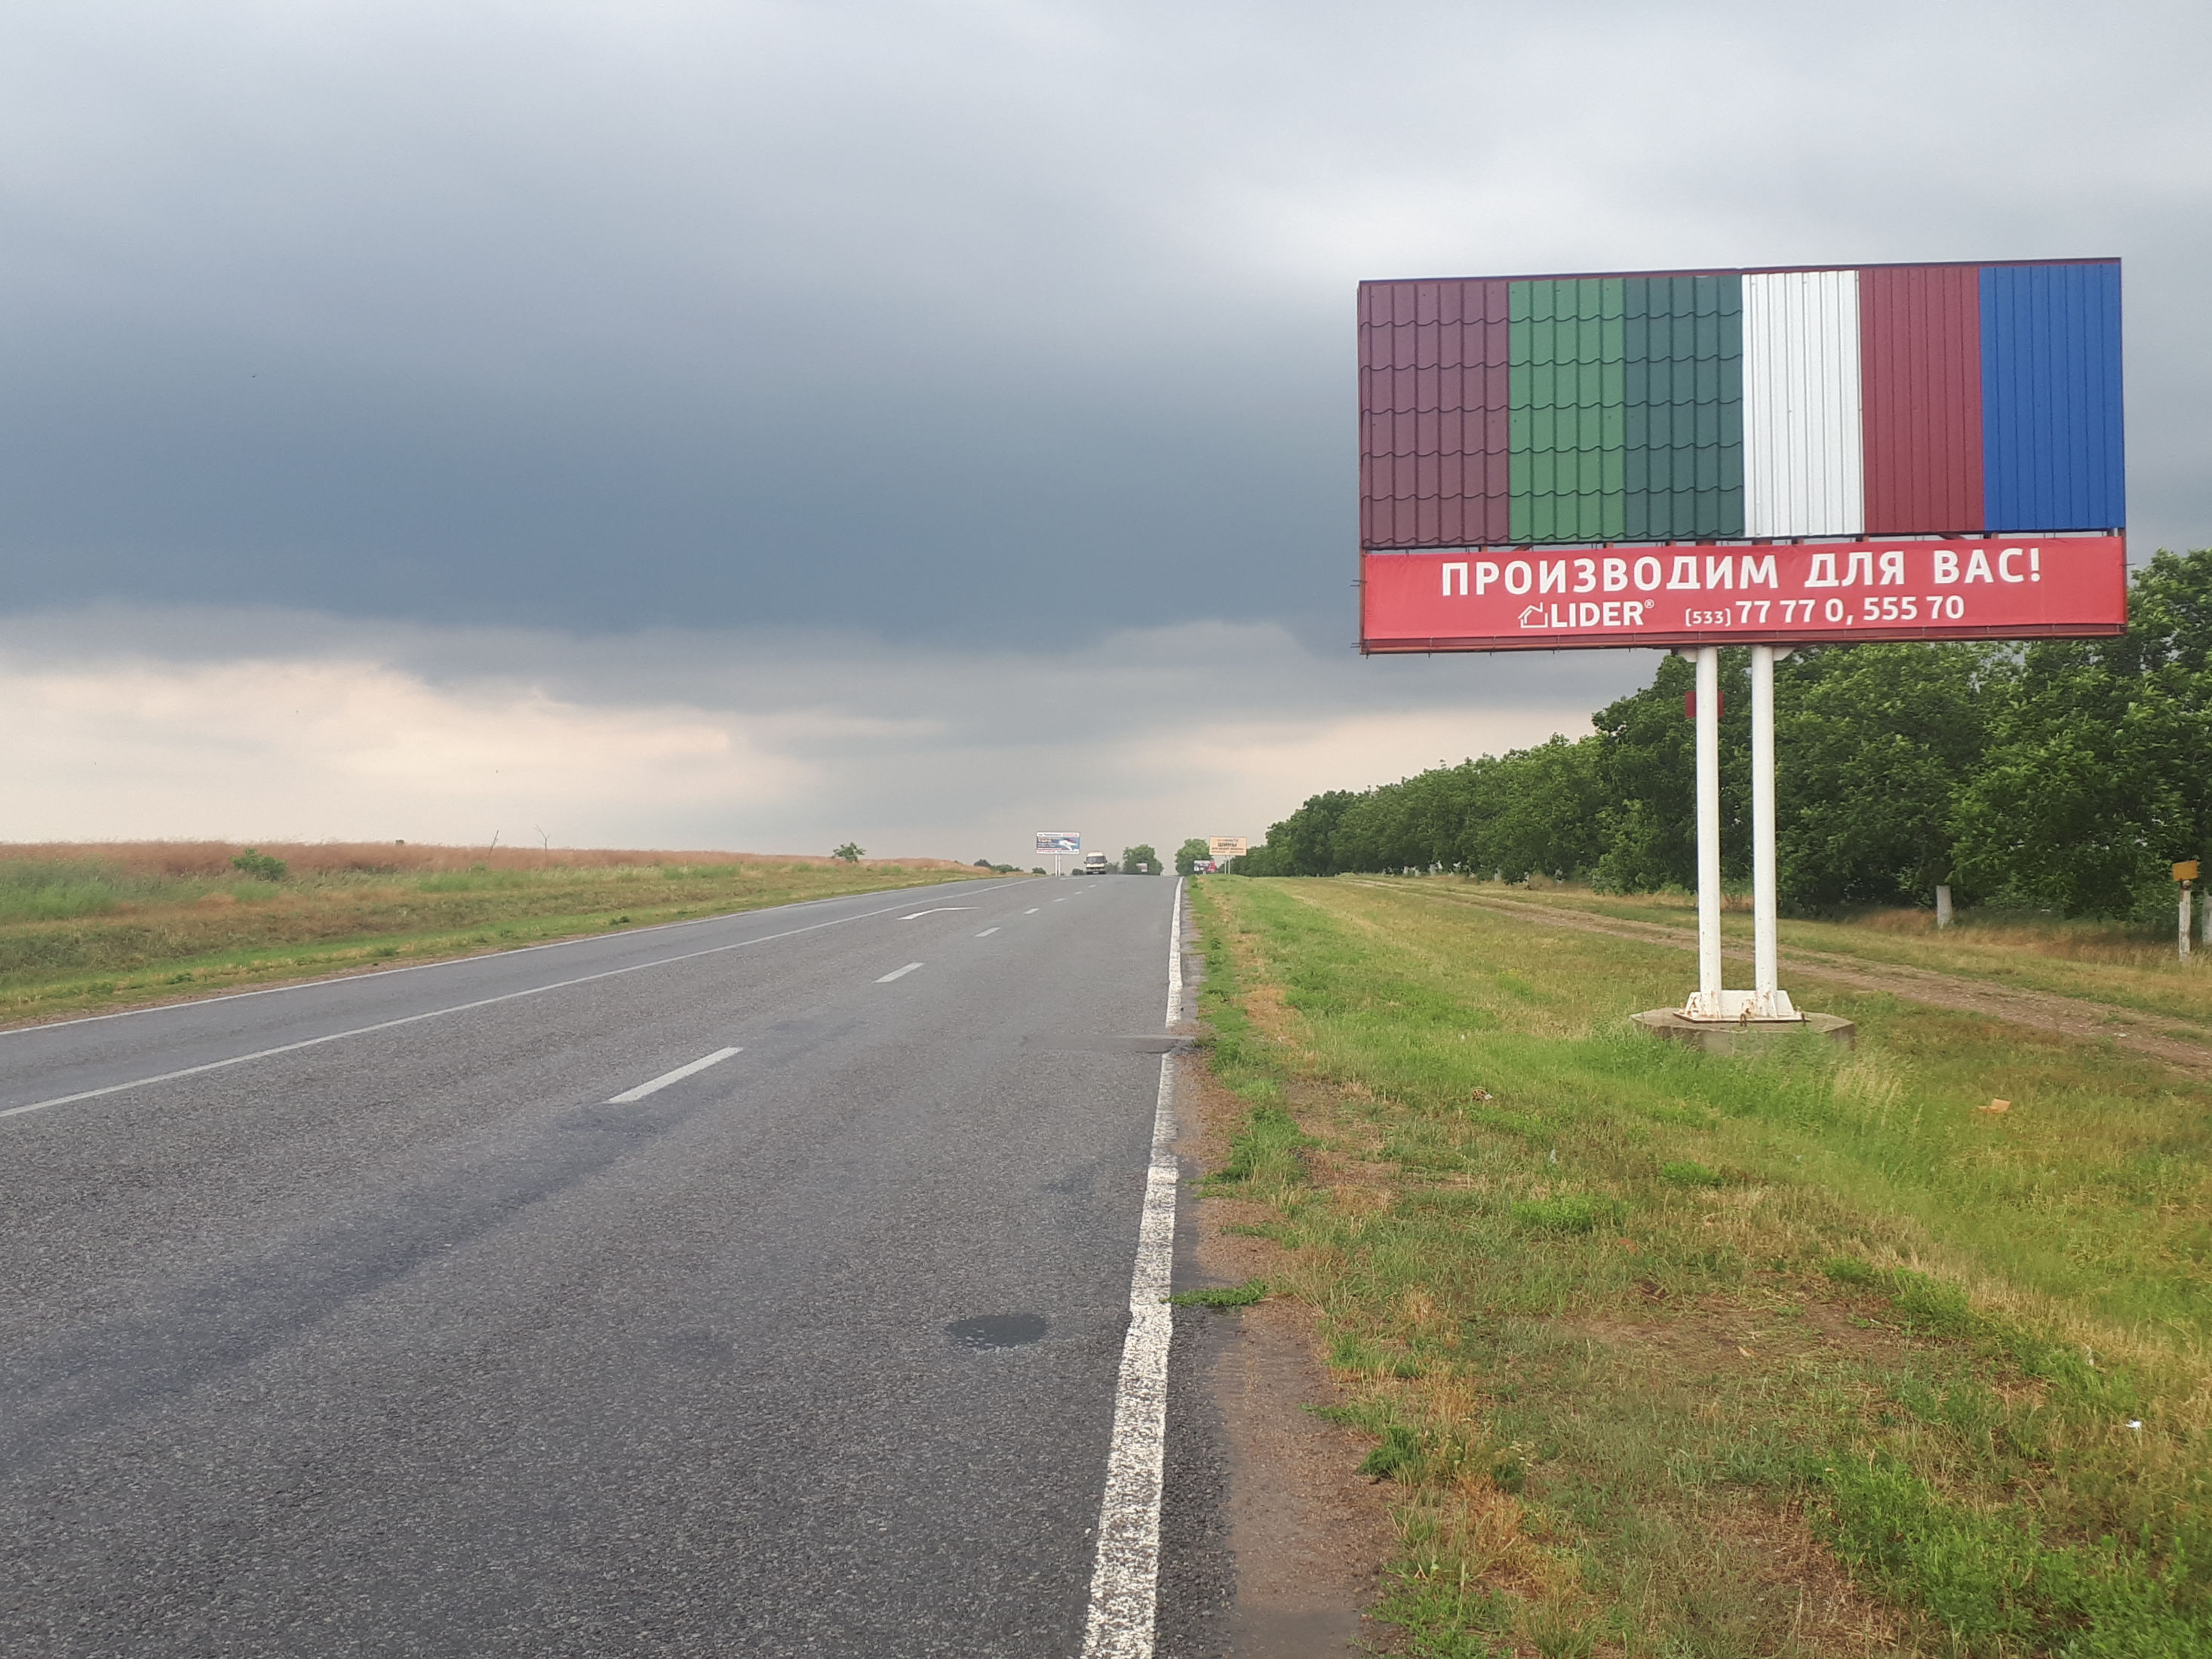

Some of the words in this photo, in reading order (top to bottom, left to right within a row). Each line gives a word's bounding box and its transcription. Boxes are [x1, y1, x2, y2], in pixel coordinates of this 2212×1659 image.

[1442, 555, 1779, 596] ПРОИЗВОДИМ
[1804, 551, 1905, 588] ДЛЯ
[1933, 548, 2041, 584] ВАС!
[1685, 607, 1731, 627] (533)
[1735, 600, 1771, 623] 77
[1779, 599, 1816, 623] 77
[1824, 598, 1854, 625] 0,
[1863, 596, 1918, 621] 555
[1925, 594, 1965, 619] 70
